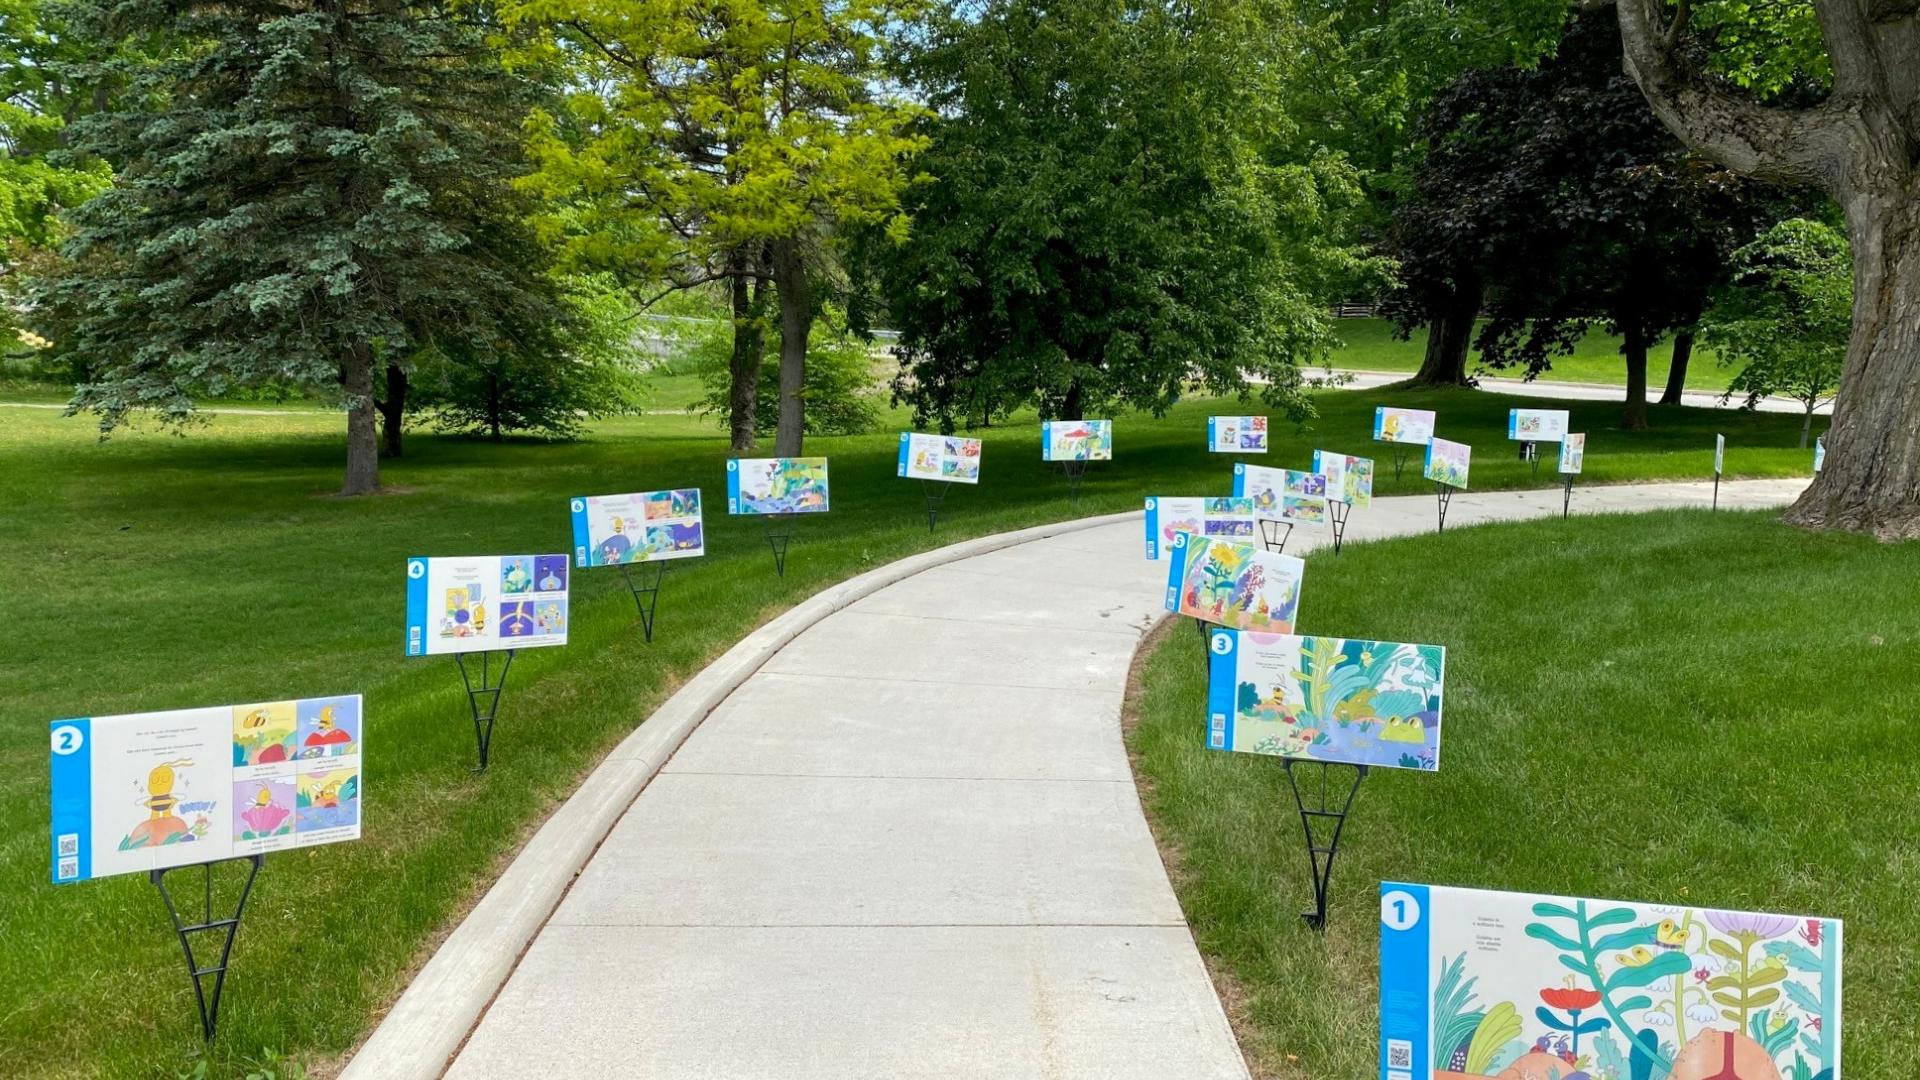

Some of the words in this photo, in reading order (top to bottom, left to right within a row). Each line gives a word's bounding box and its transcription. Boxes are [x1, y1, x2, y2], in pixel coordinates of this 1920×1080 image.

[574, 502, 581, 511] 6
[1175, 537, 1183, 546] 5
[412, 565, 420, 575] 4
[1217, 638, 1226, 651] 3
[60, 732, 73, 750] 2
[1392, 900, 1406, 923] 1
